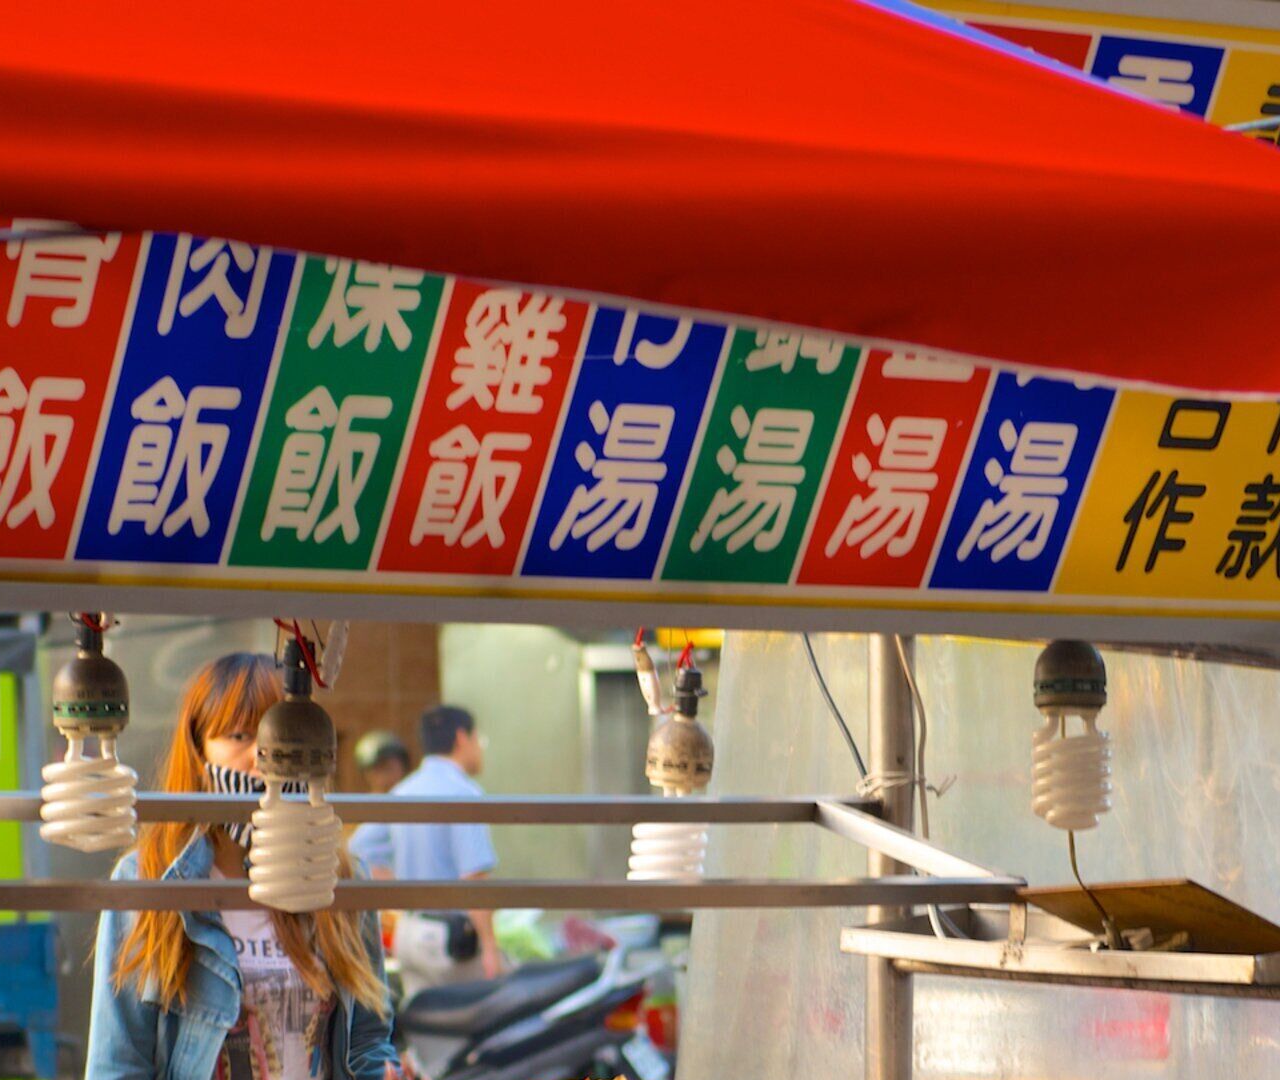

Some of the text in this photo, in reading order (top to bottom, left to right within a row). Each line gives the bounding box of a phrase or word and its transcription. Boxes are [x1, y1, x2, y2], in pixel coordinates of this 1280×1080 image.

[408, 287, 568, 550] 雞飯
[824, 350, 977, 560] 湯
[955, 372, 1097, 564] 湯
